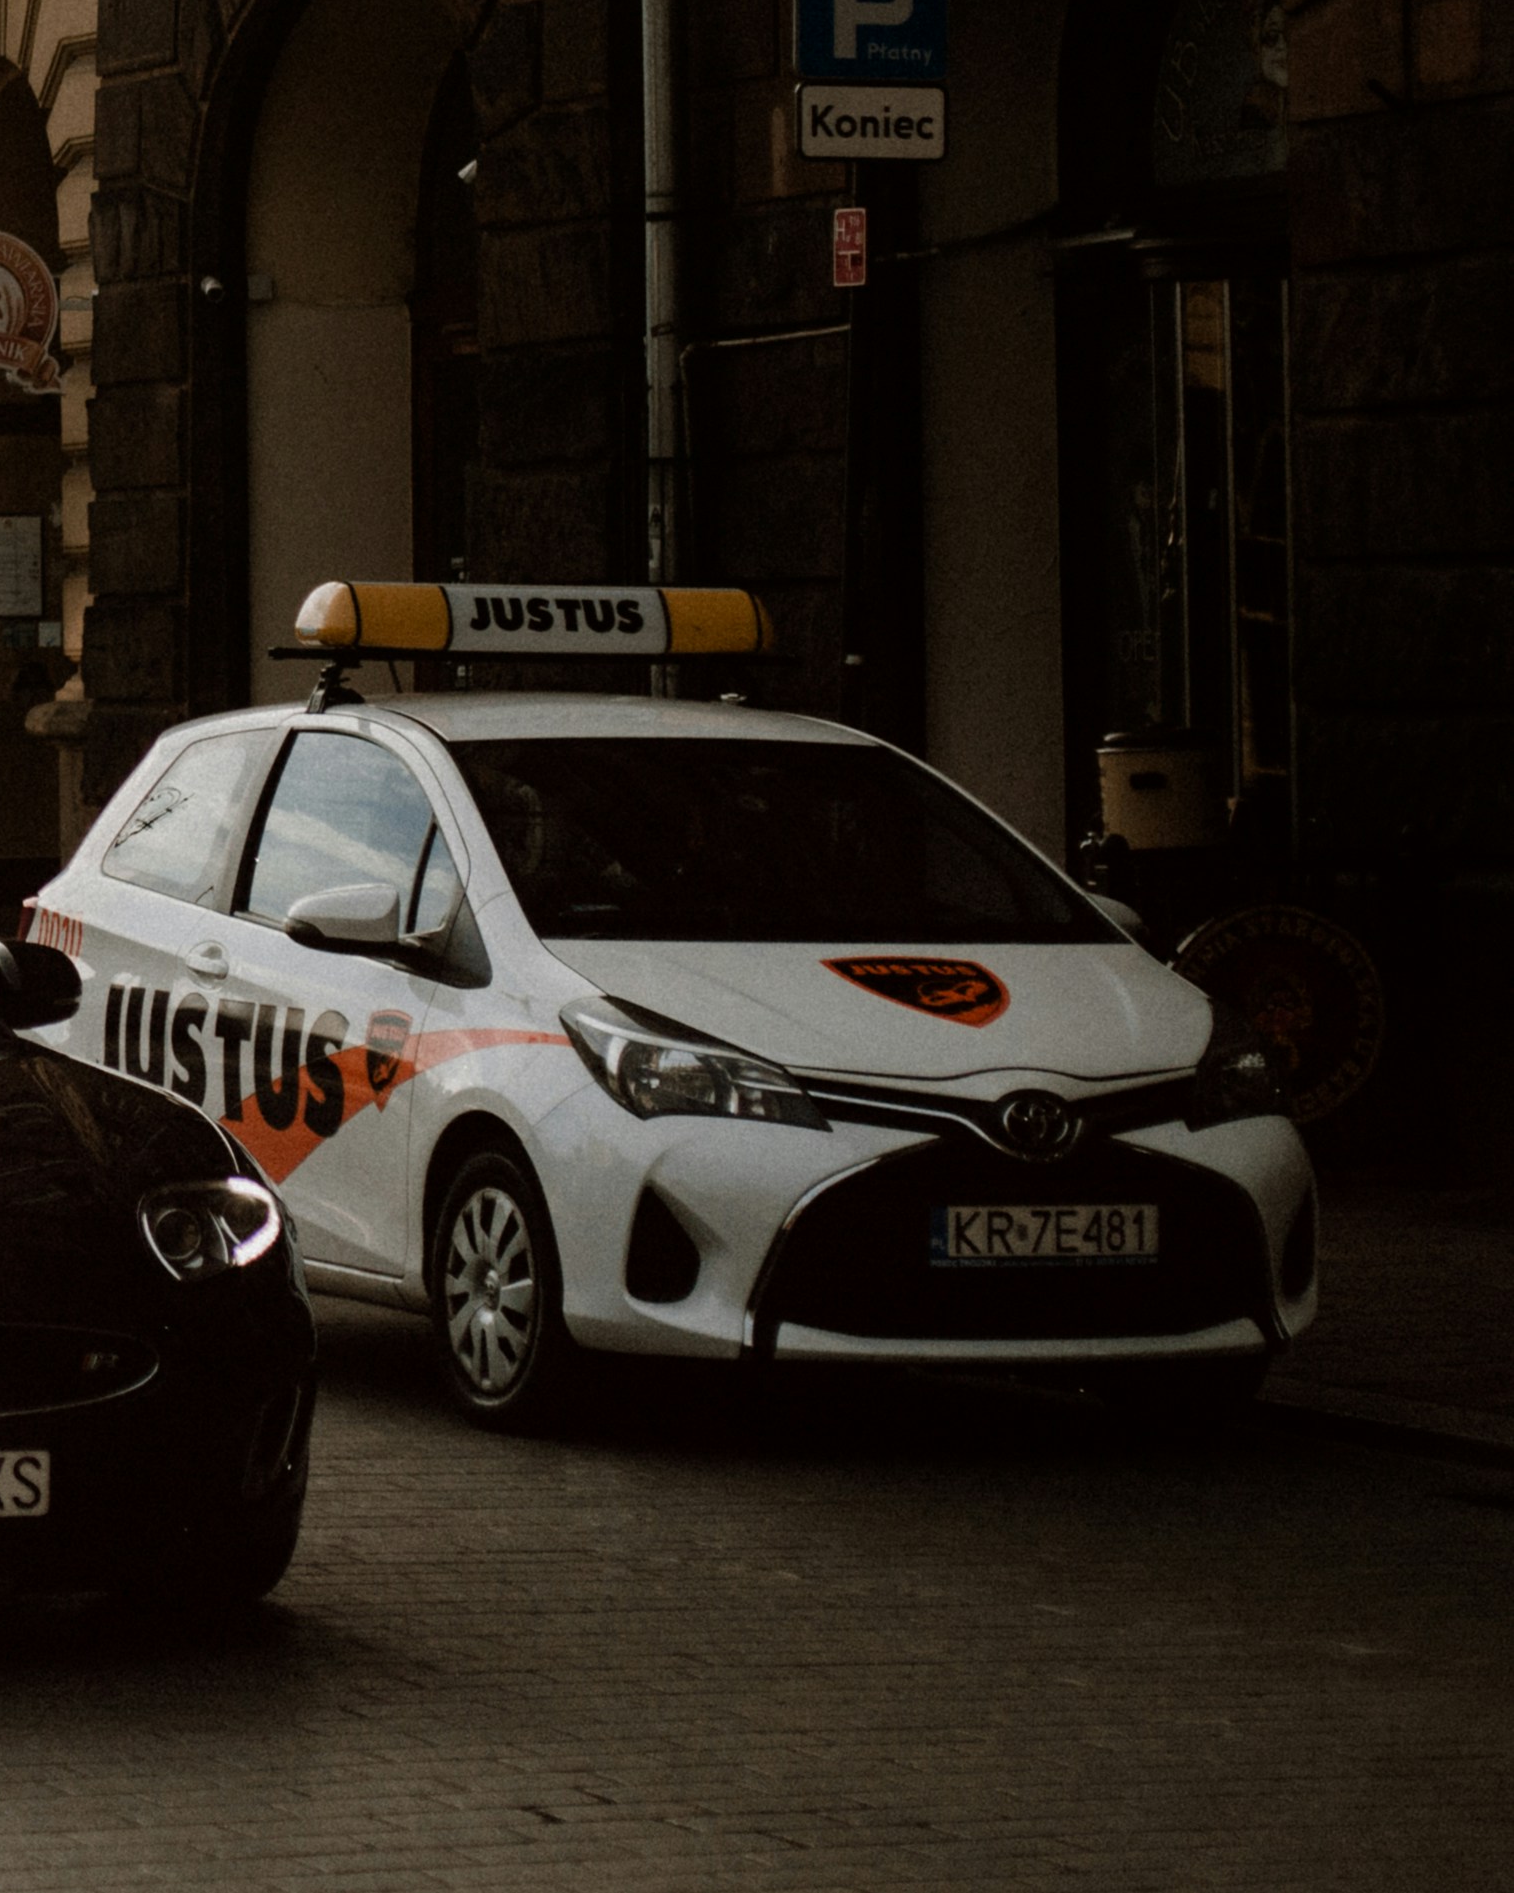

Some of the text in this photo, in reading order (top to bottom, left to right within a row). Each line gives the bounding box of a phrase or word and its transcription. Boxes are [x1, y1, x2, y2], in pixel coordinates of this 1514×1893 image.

[811, 104, 934, 140] Koniec
[470, 596, 644, 633] JUSTUS
[954, 1209, 1146, 1254] KR 7E481
